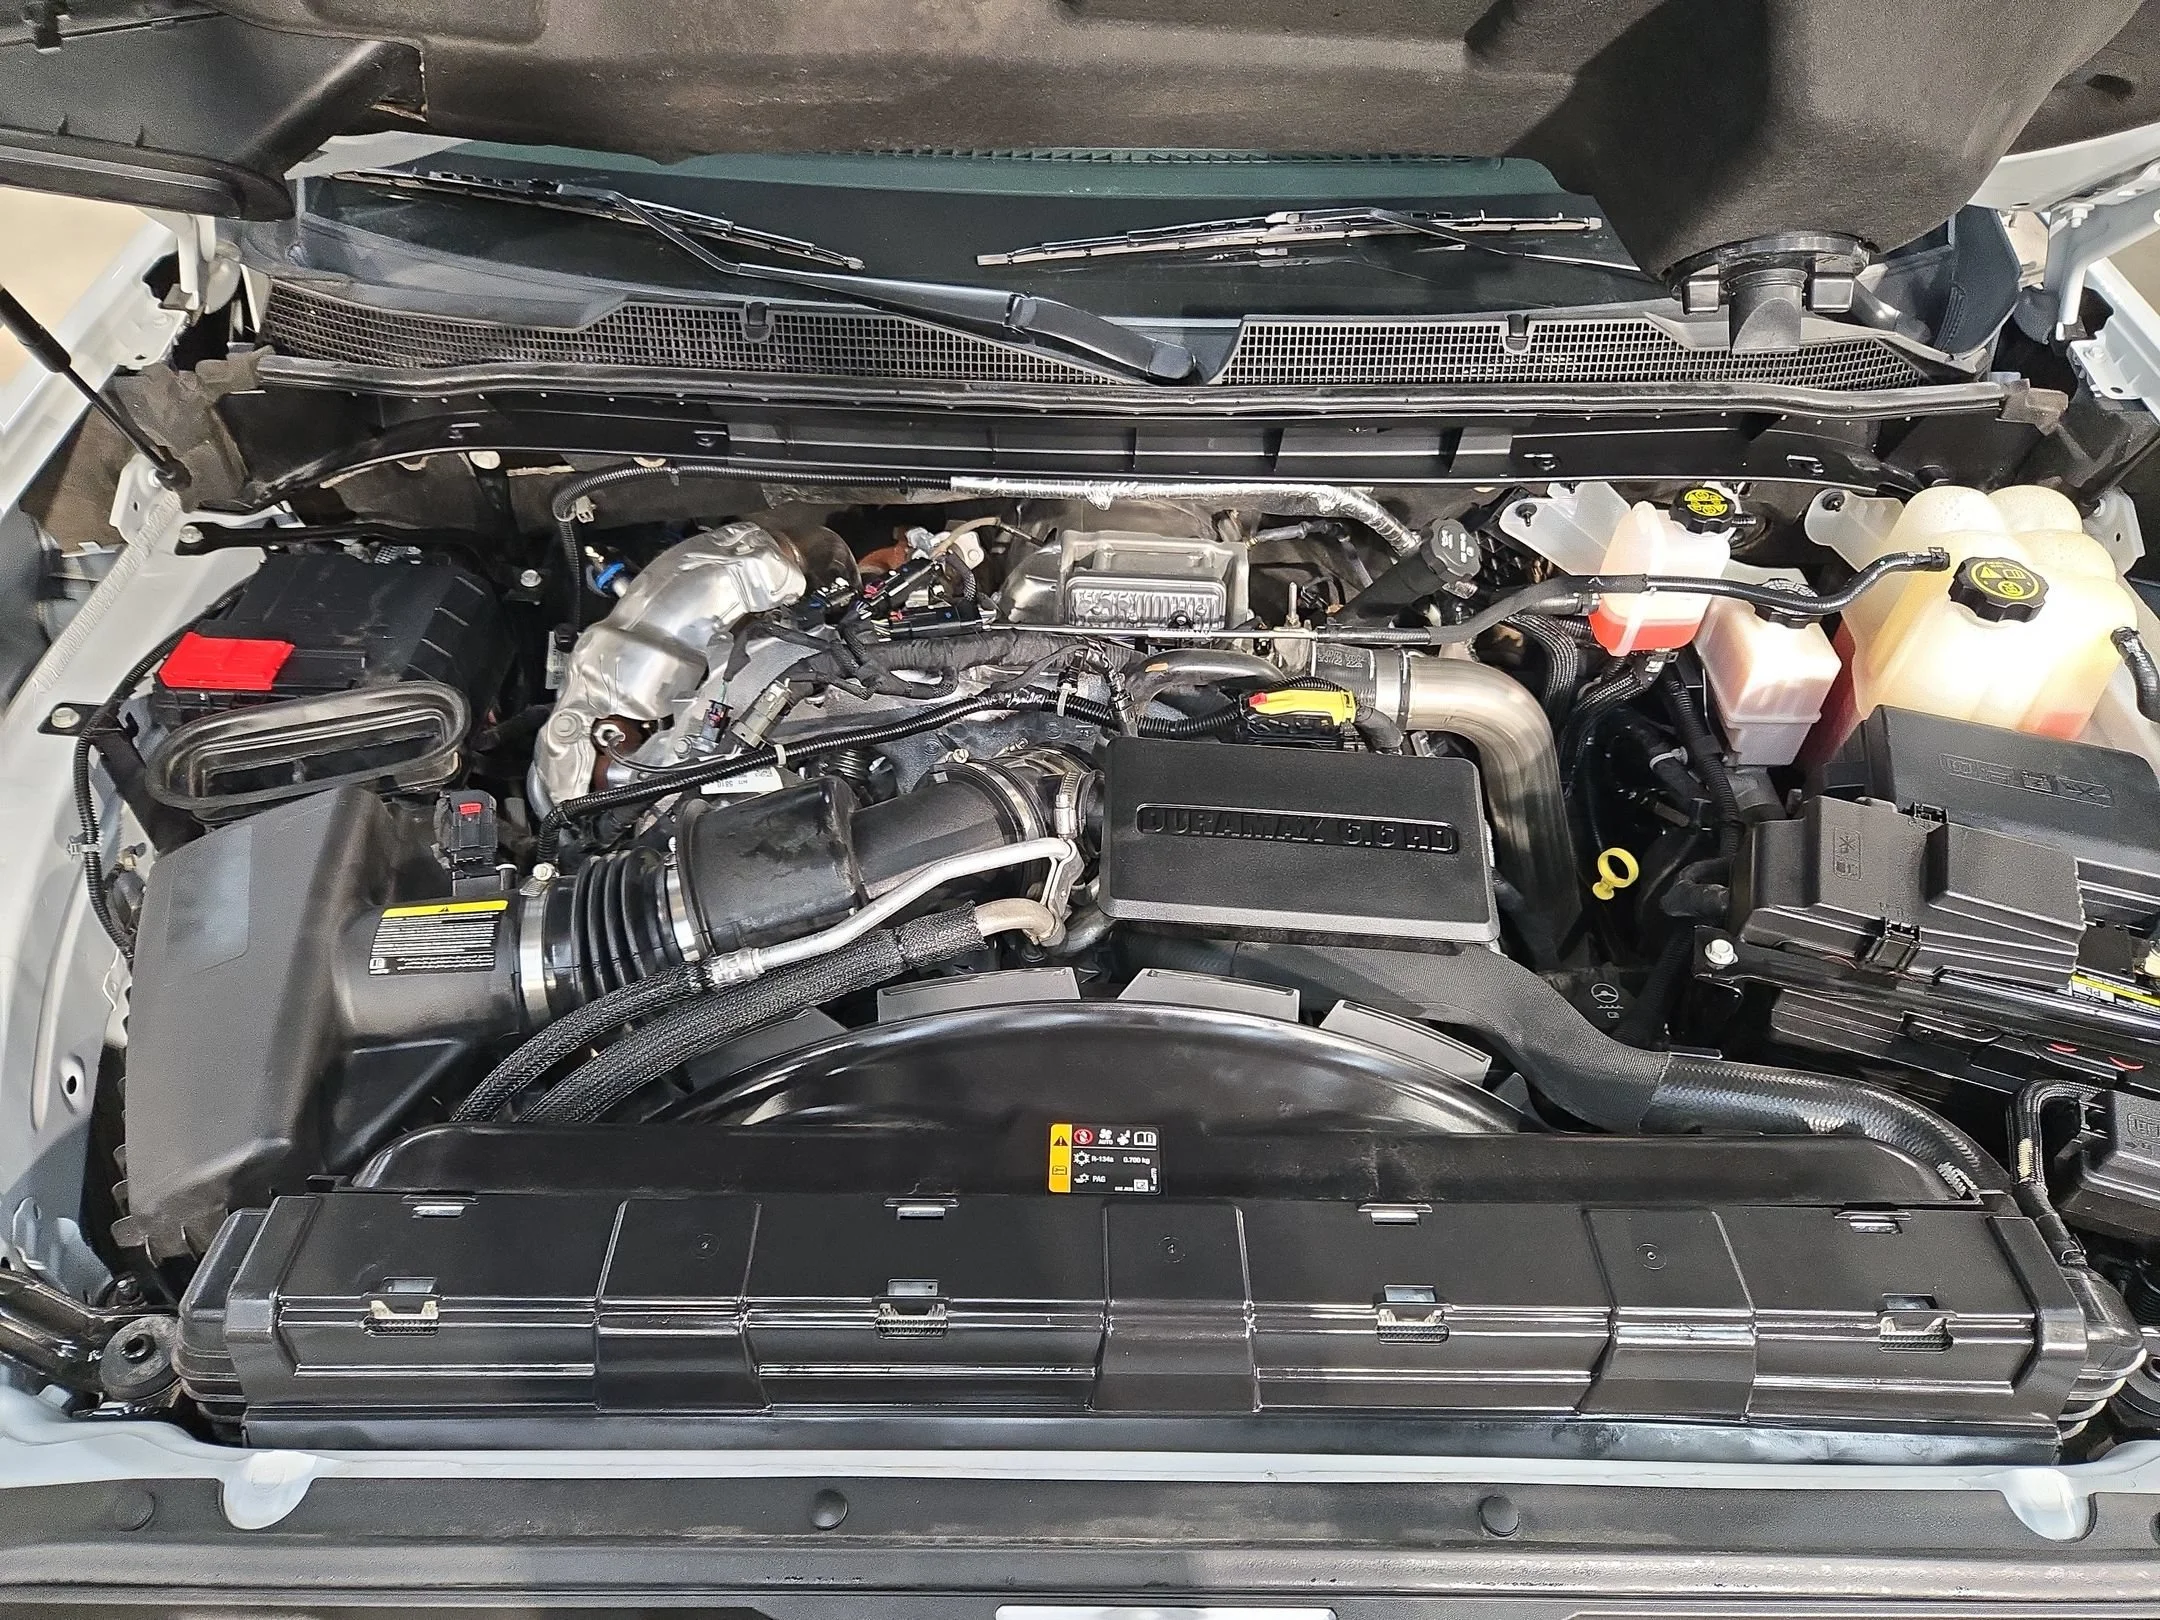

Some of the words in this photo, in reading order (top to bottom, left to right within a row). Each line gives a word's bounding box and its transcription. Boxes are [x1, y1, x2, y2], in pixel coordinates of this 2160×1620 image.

[1142, 808, 1325, 842] DURAMAX
[1403, 822, 1453, 851] HD
[1091, 1155, 1114, 1163] R-134a
[1141, 1157, 1151, 1165] kg
[1092, 1175, 1107, 1183] PAG
